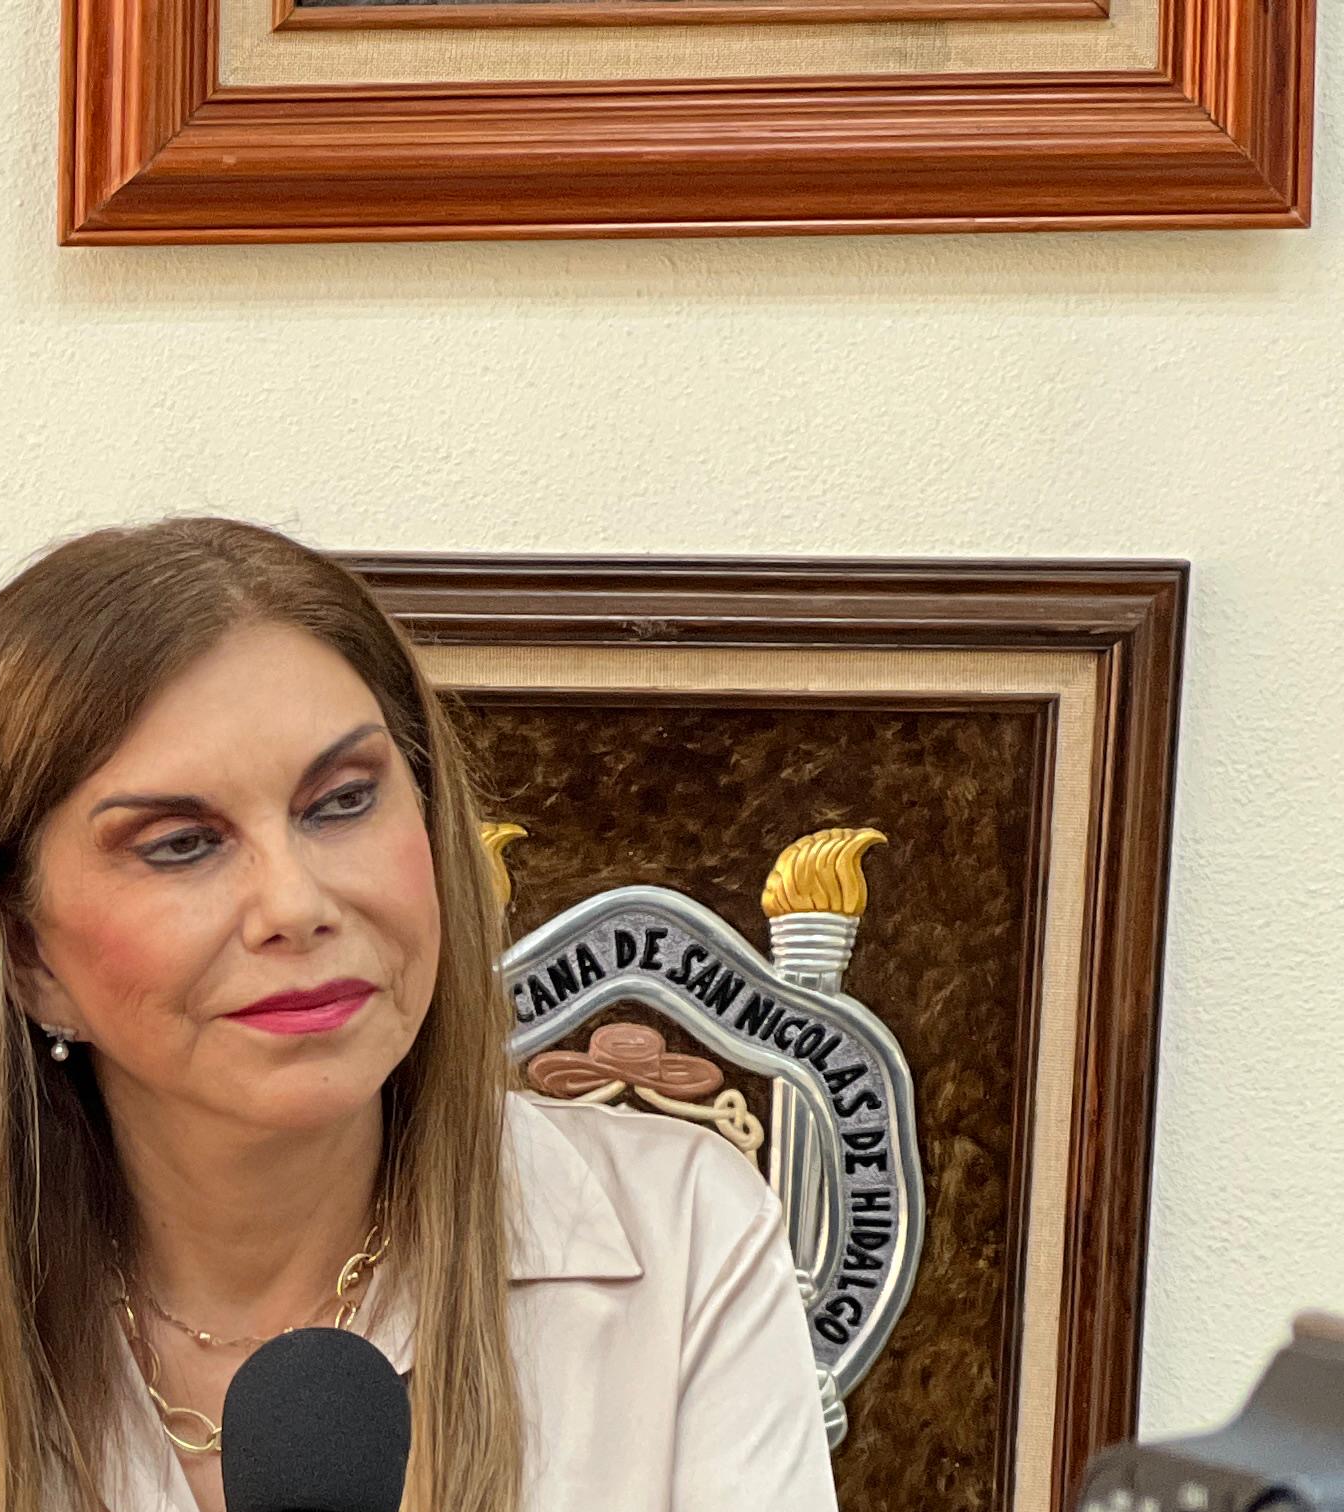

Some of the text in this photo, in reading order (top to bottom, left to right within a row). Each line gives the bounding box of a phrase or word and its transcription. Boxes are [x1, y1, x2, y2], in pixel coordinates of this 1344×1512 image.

[614, 927, 668, 969] DE
[665, 943, 746, 1016] SAN
[734, 998, 882, 1119] NICOLAS
[841, 1128, 887, 1175] DE
[815, 1187, 893, 1347] HIDALGO
